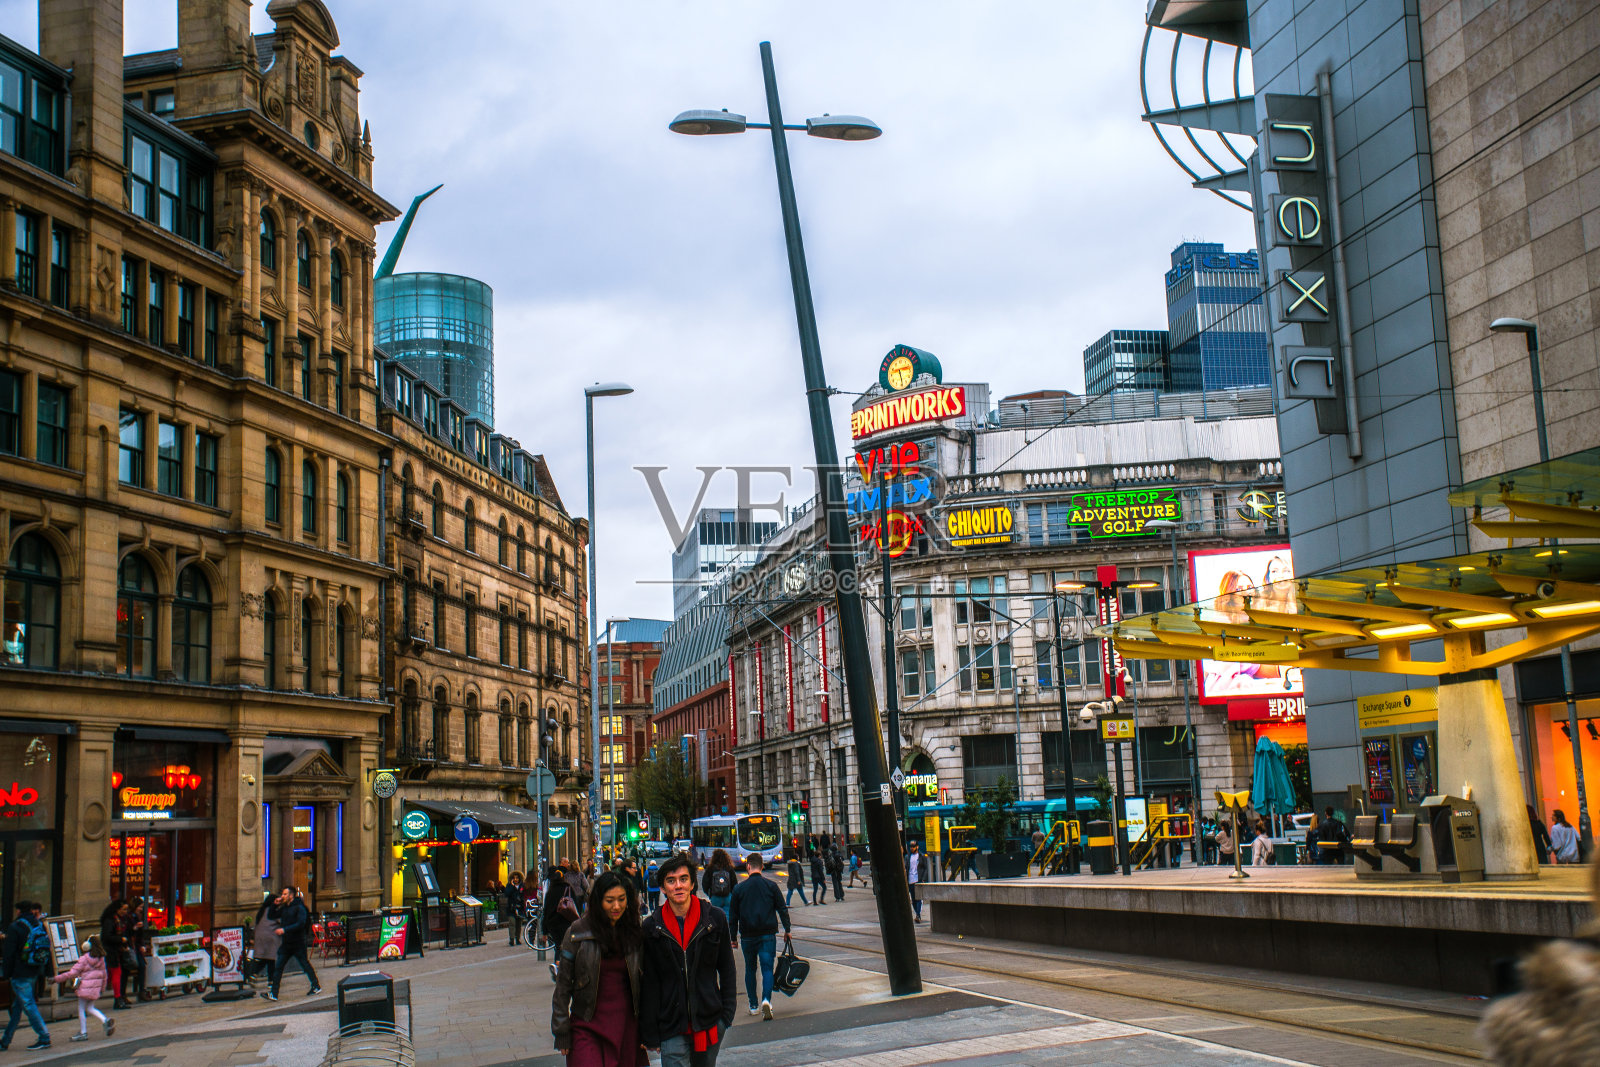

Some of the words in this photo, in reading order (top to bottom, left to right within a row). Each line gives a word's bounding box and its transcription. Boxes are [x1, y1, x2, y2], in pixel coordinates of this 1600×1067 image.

[1203, 254, 1259, 269] CIS
[1271, 123, 1334, 387] next
[858, 388, 962, 436] PRINTWORKS
[848, 476, 936, 515] IMAX
[1084, 492, 1159, 507] TREETOP
[948, 507, 1012, 536] CHIQUITO
[1071, 505, 1175, 522] ADVENTURE
[1103, 520, 1145, 533] GOLF
[1269, 698, 1277, 717] THE
[1363, 703, 1384, 712] Exchange
[1385, 701, 1401, 710] Square
[120, 787, 176, 810] Tampopo
